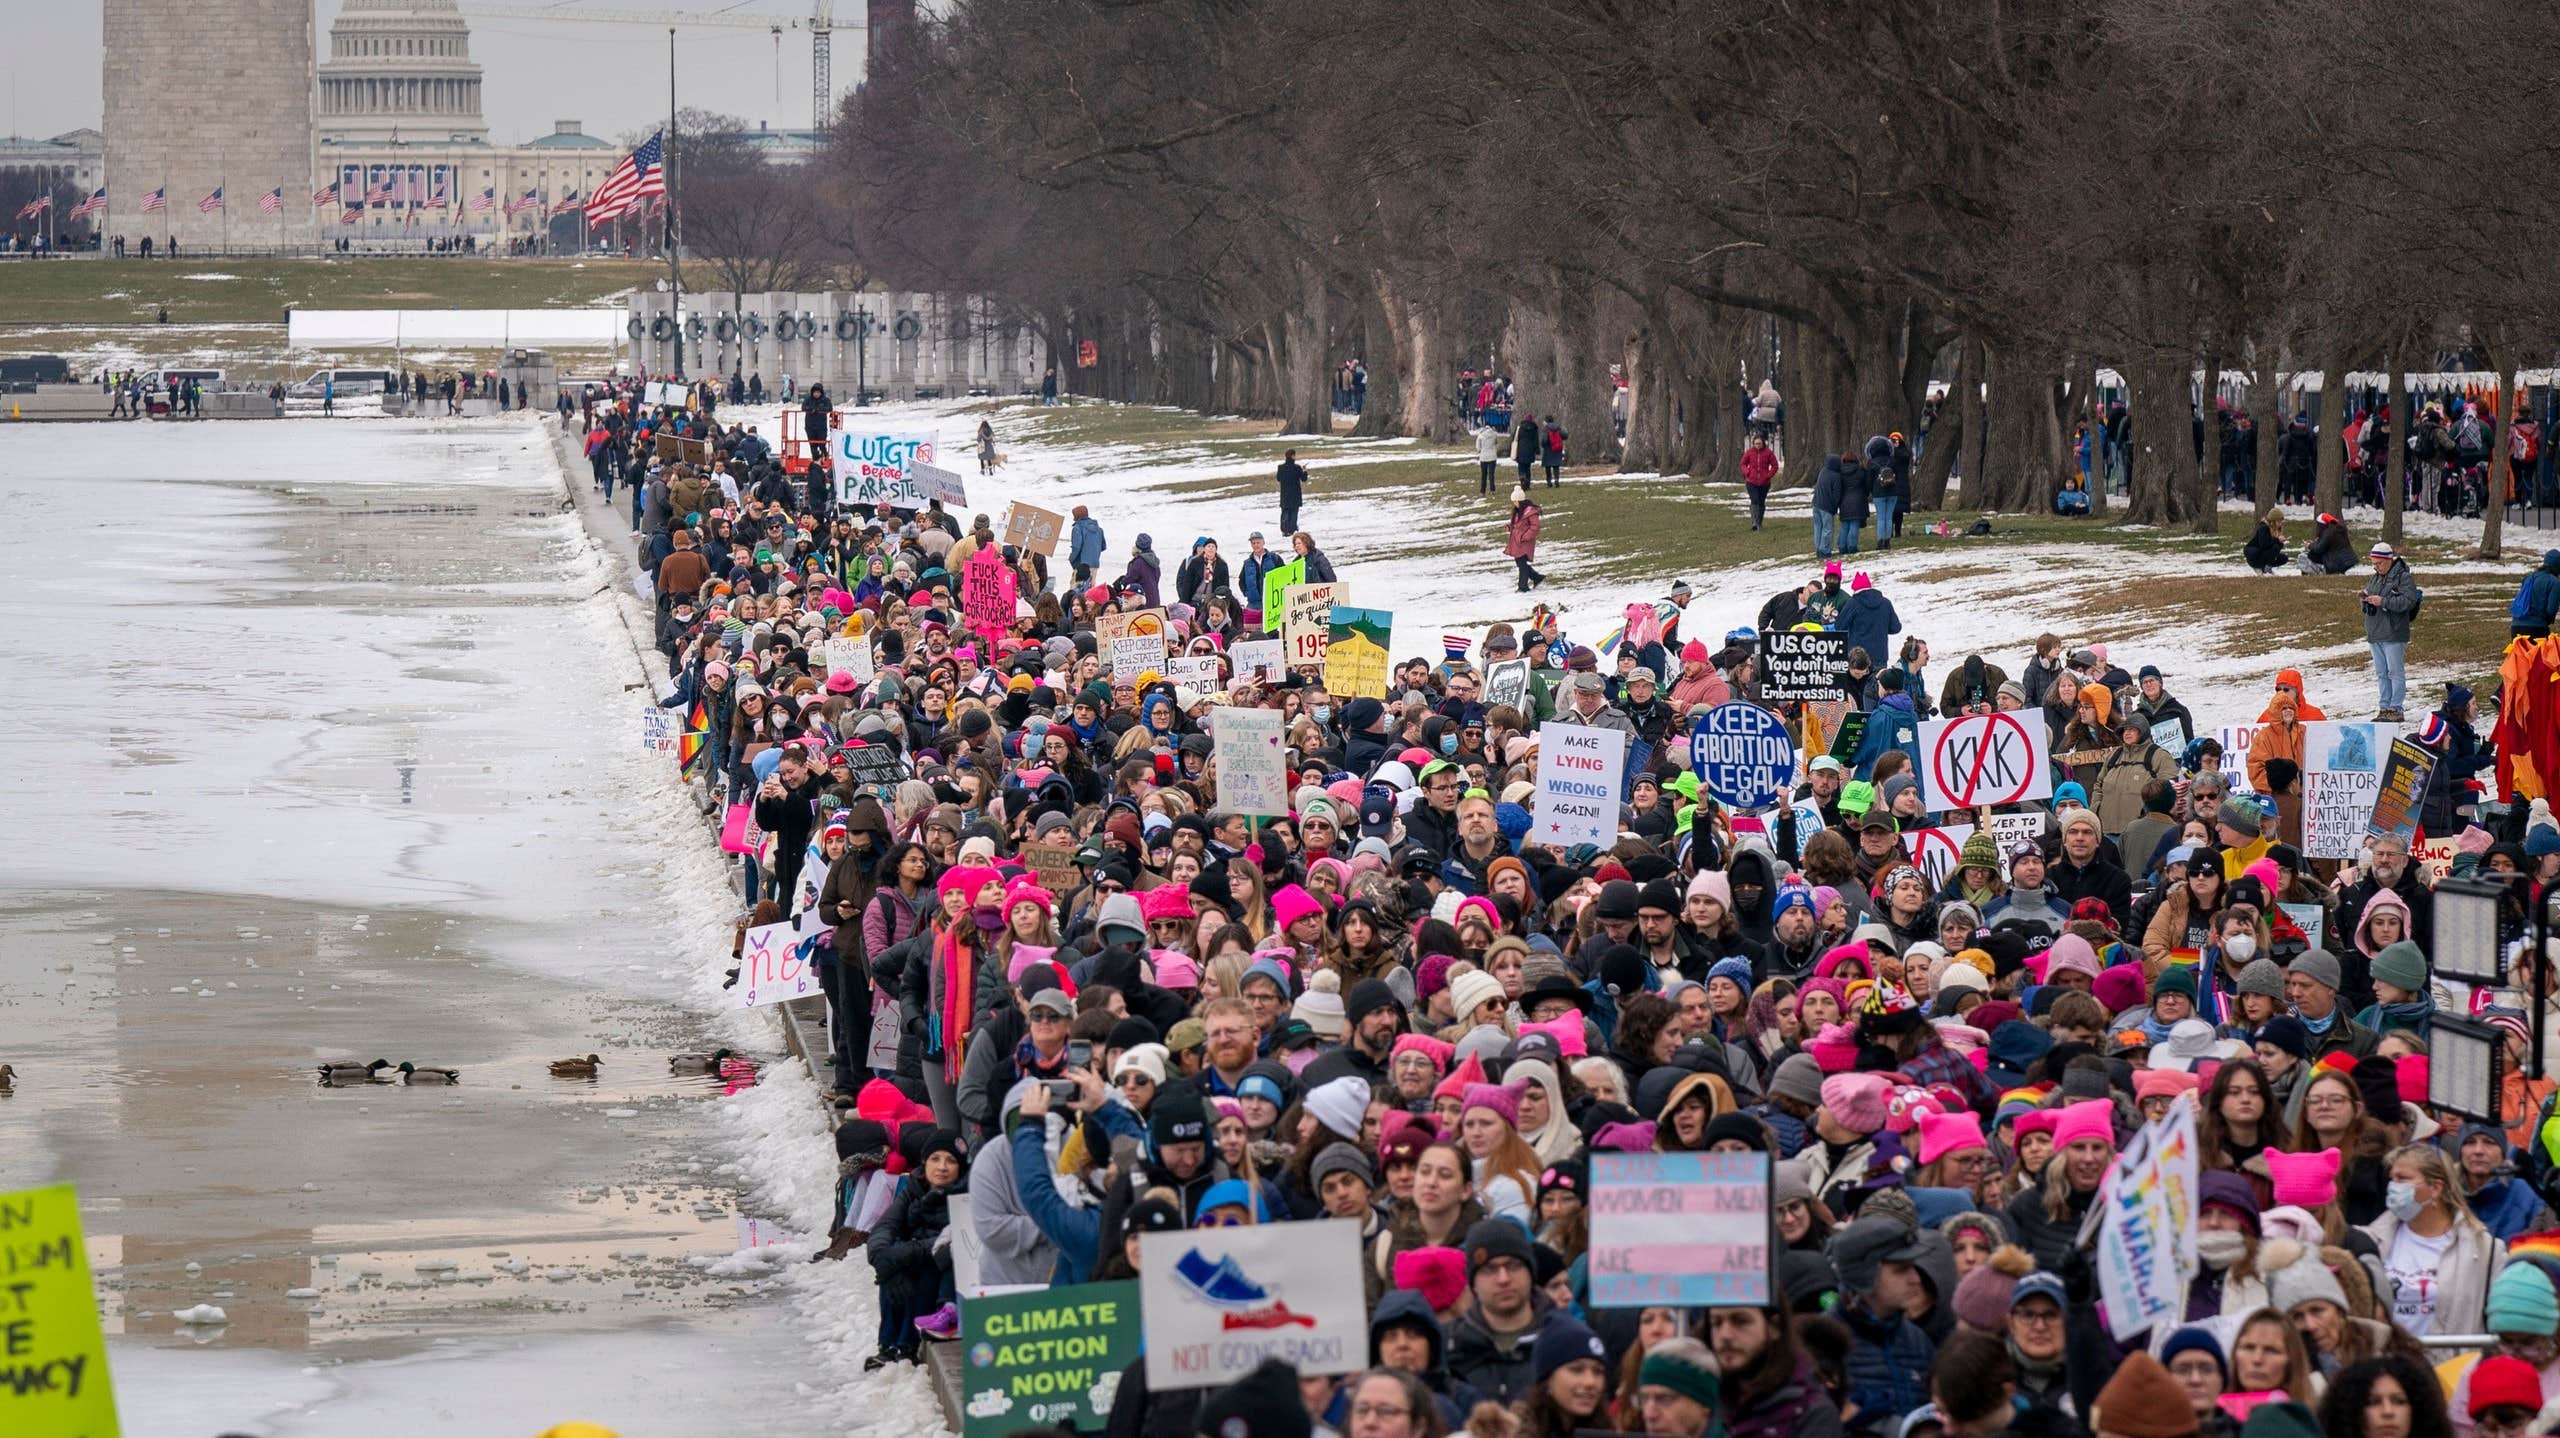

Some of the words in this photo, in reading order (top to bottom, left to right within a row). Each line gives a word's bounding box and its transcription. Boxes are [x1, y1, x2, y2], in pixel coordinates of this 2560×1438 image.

[861, 464, 903, 480] Before
[971, 563, 1000, 581] FUCK
[970, 578, 1000, 596] THIS
[1292, 596, 1296, 606] I
[1297, 591, 1311, 604] WILL
[1312, 586, 1331, 600] NOT
[1100, 614, 1126, 627] TRUMP
[1291, 608, 1304, 626] go
[1113, 638, 1135, 656] KEEP
[1296, 634, 1328, 658] 195
[1115, 654, 1133, 665] and
[1131, 650, 1162, 664] STATE
[1170, 660, 1194, 675] Bans
[1200, 658, 1217, 672] OFF
[1765, 654, 1791, 672] You
[1793, 655, 1821, 672] don't
[1822, 656, 1849, 672] have
[1773, 671, 1788, 685] to
[1791, 671, 1807, 685] be
[1808, 671, 1834, 685] this
[1761, 684, 1845, 702] Embarrassing
[1709, 705, 1773, 735] KEEP
[1564, 735, 1600, 750] MAKE
[2223, 728, 2229, 750] I
[1694, 733, 1791, 766] ABORTION
[1556, 754, 1605, 771] LYING
[1948, 732, 2019, 793] KKK
[1223, 772, 1259, 791] SAVE
[1704, 763, 1783, 795] LEGAL
[2226, 771, 2242, 787] ND
[2307, 772, 2378, 790] TRAITOR
[1548, 779, 1608, 798] WRONG
[2308, 789, 2356, 805] RAPIST
[2021, 817, 2037, 827] TO
[2308, 805, 2373, 821] UNTRUTHF
[1992, 829, 2036, 841] PEOPLE
[2306, 821, 2370, 836] MANIPULA
[2307, 835, 2352, 848] PHONY
[2308, 847, 2349, 858] AMERICA'S
[2410, 846, 2452, 862] TEMIC
[1040, 869, 1082, 884] GAINST
[1594, 1186, 1684, 1214] WOMEN
[1714, 1185, 1768, 1212] MEN
[1595, 1248, 1635, 1274] ARE
[1721, 1245, 1764, 1271] ARE
[2397, 1304, 2417, 1315] AND
[984, 1301, 1118, 1337] CLIMATE
[994, 1335, 1109, 1368] ACTION
[1170, 1343, 1211, 1373] NOT
[1283, 1334, 1343, 1367] BACK!
[1011, 1367, 1094, 1397] NOW!
